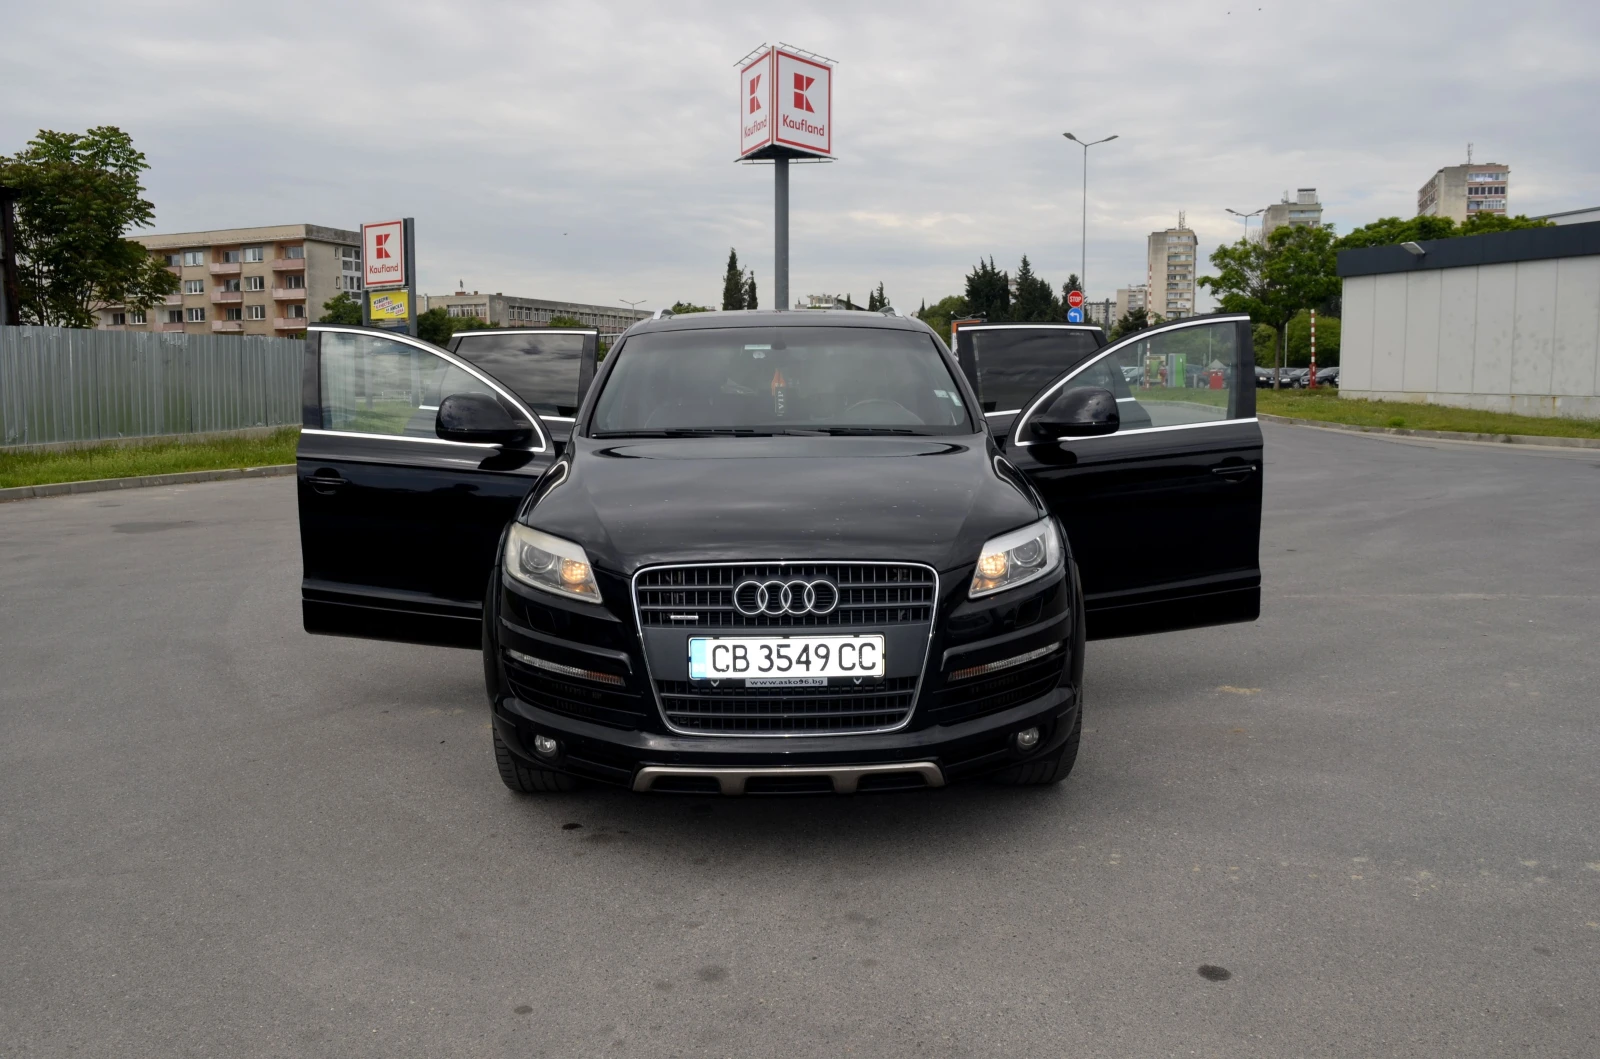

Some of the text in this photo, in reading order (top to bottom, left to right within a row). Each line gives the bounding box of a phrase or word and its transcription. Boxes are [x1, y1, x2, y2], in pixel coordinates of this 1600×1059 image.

[744, 114, 767, 138] Kaufland
[782, 113, 825, 137] Kaufland
[369, 262, 399, 275] Kaufland
[712, 642, 877, 673] CB 3549 CC
[749, 678, 824, 686] www.asko96.bg
